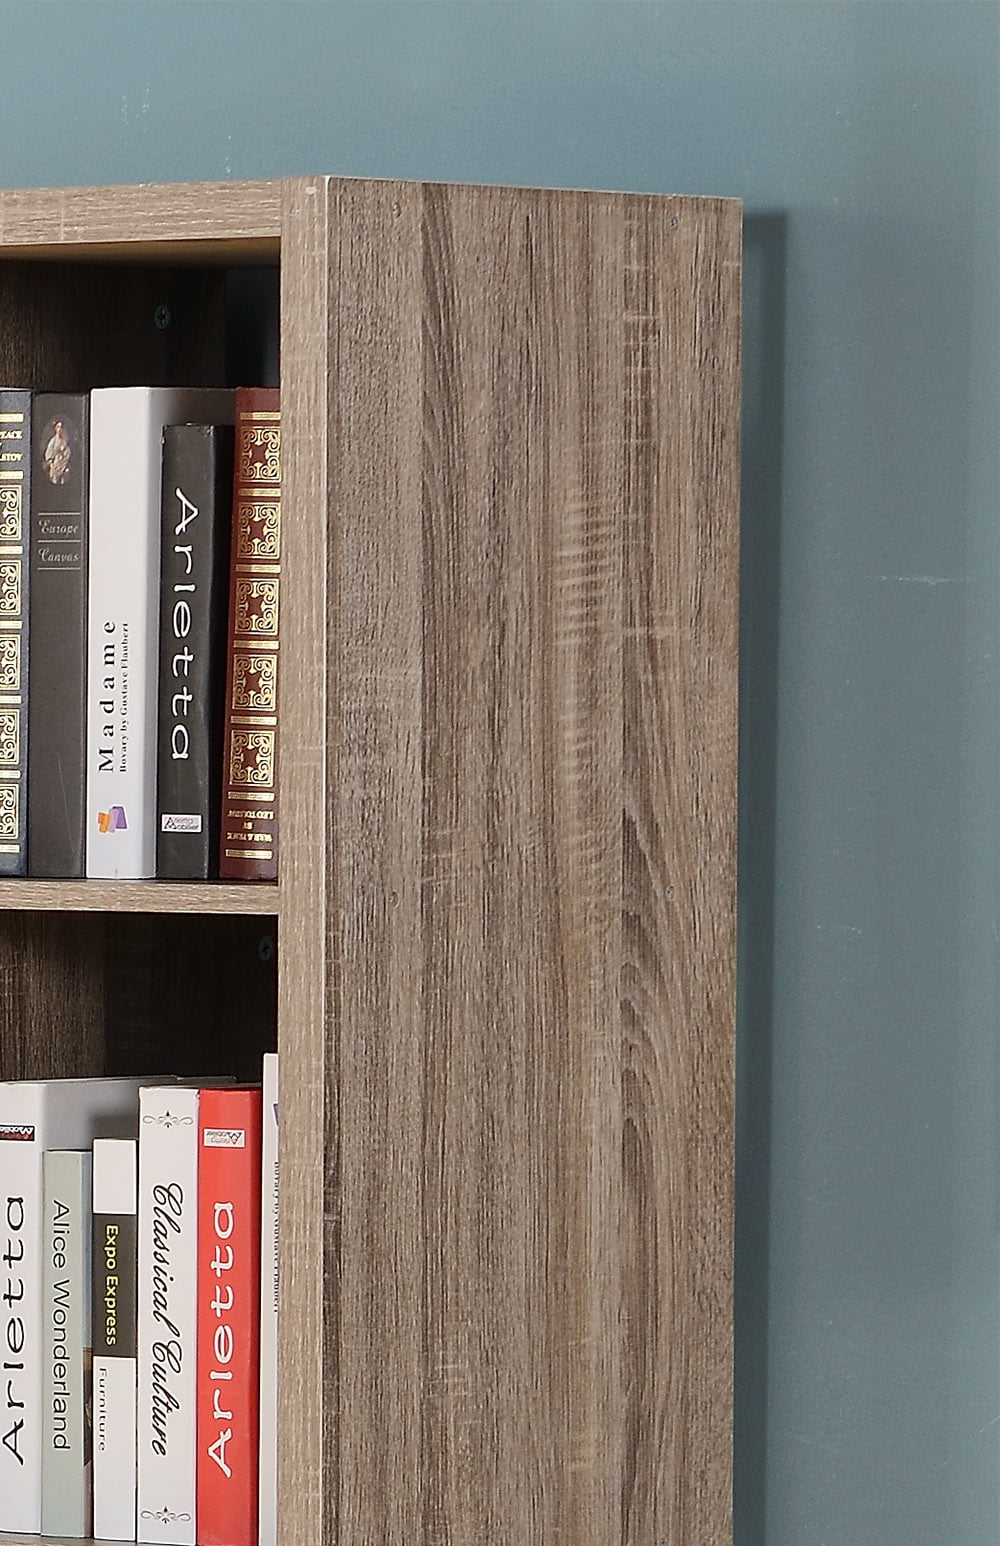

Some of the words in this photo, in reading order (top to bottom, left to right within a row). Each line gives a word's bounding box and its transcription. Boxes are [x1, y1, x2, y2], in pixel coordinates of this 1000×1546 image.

[38, 519, 79, 538] Europe
[38, 548, 79, 562] Canvas
[121, 623, 129, 669] Flaubert
[98, 621, 116, 773] Madame
[120, 672, 129, 716] Gustave
[120, 720, 129, 731] by
[120, 735, 129, 773] Bovary
[53, 1200, 70, 1269] Alice
[104, 1225, 119, 1269] Expo
[152, 1183, 184, 1337] Classical
[104, 1276, 119, 1346] Express
[53, 1279, 71, 1450] Wonderland
[98, 1367, 108, 1452] Furniture
[152, 1340, 183, 1456] Culture
